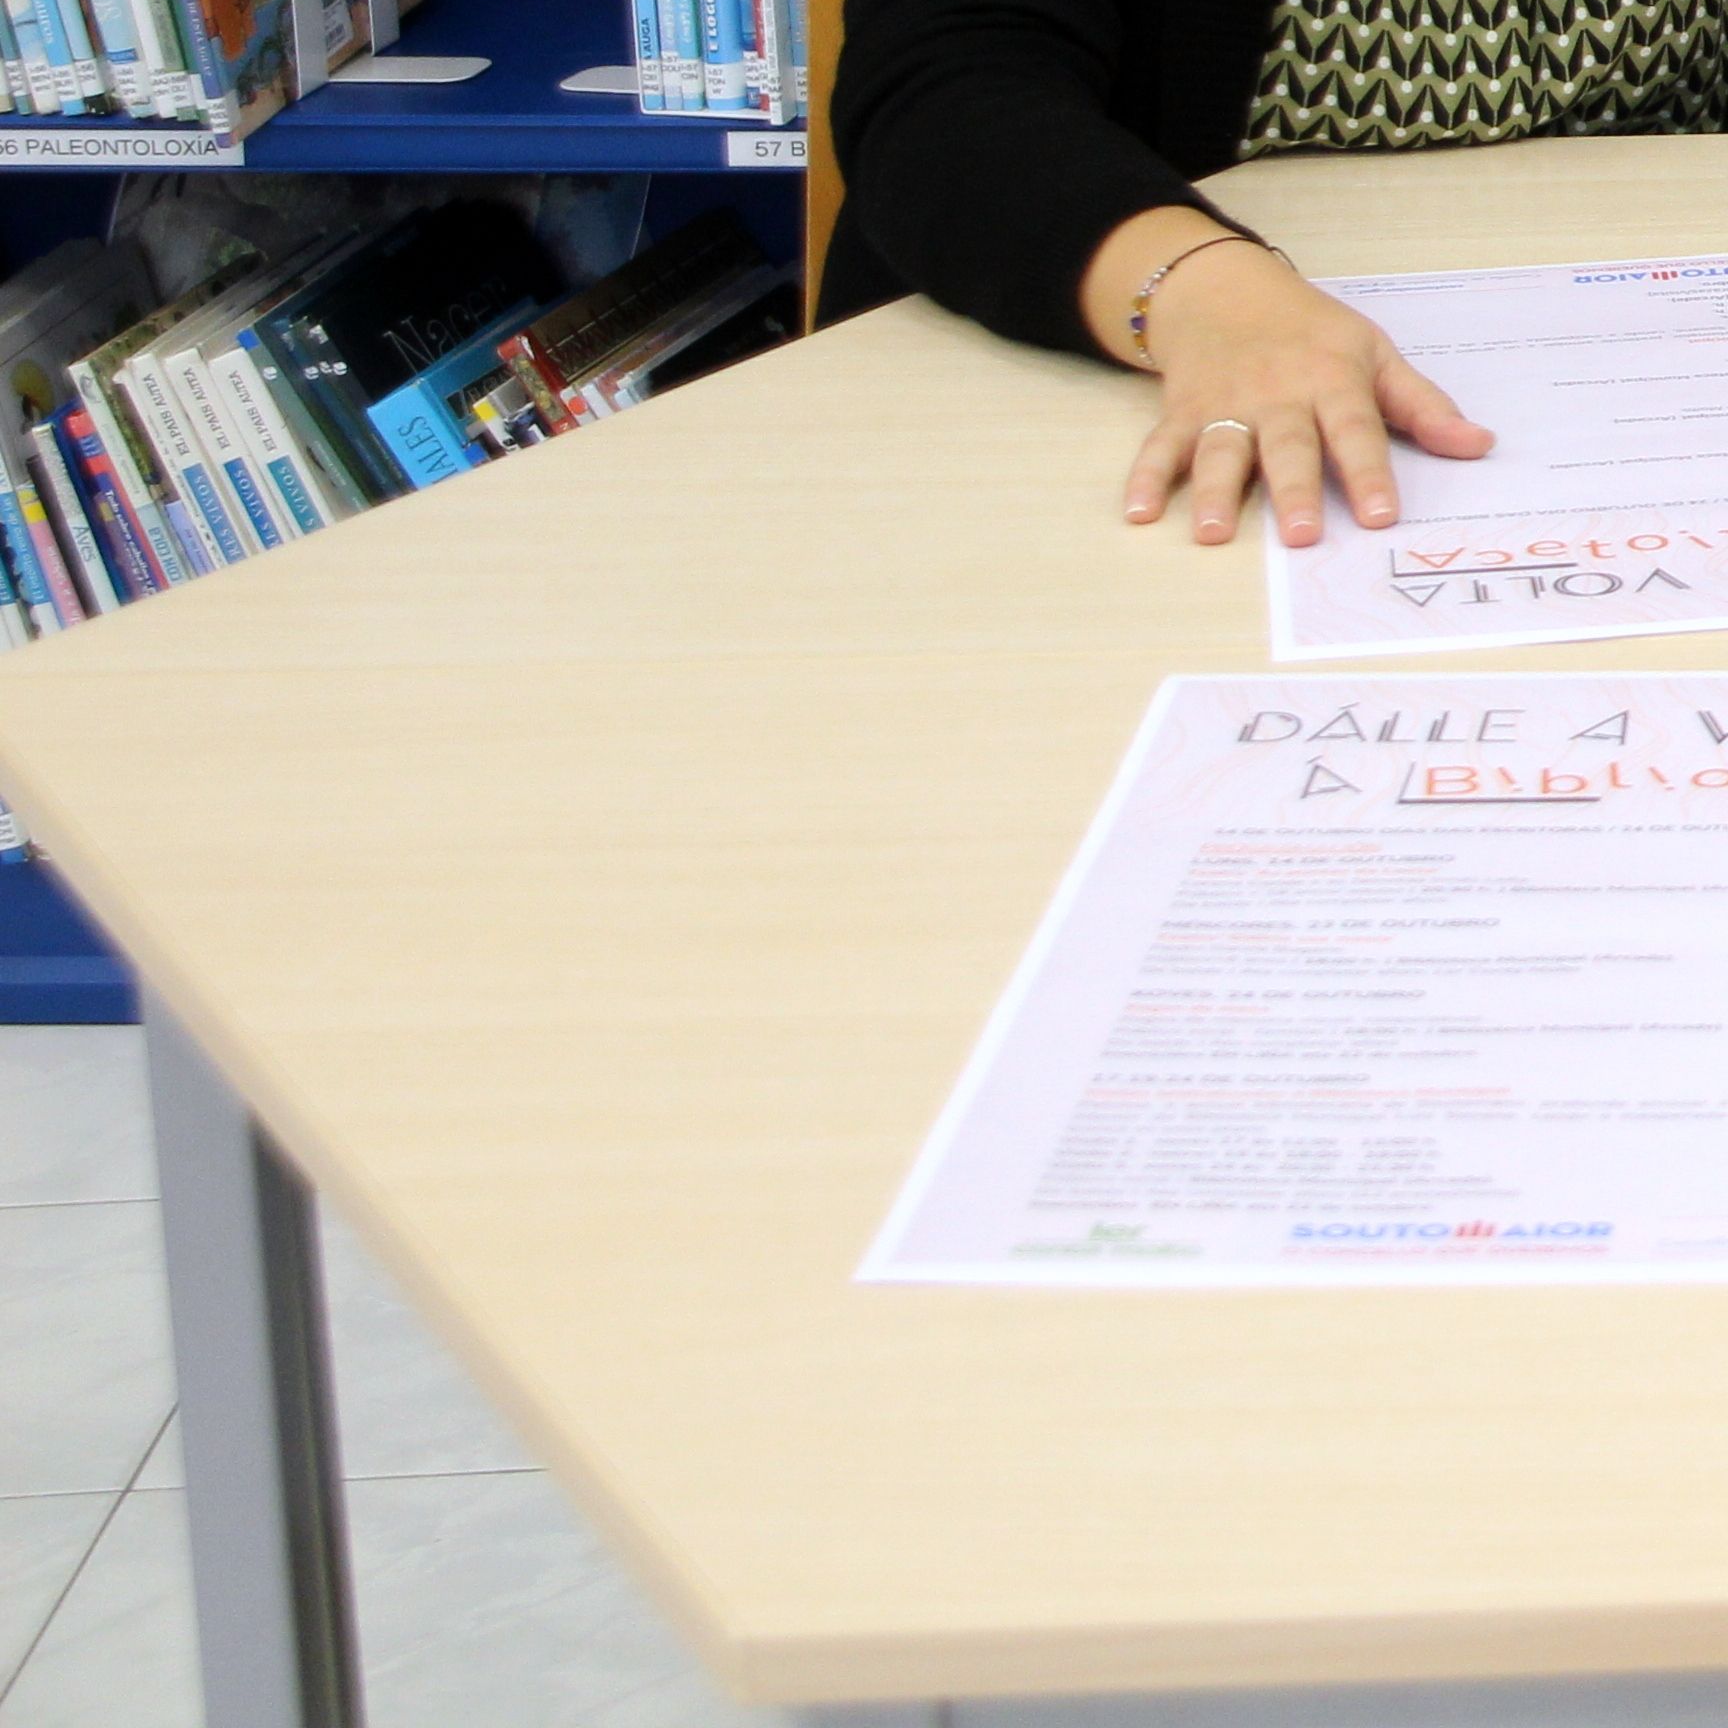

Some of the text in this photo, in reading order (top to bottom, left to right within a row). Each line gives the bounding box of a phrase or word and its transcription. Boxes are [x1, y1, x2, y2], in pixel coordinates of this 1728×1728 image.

[26, 135, 220, 156] PALEONTOLOXÍA
[755, 139, 784, 158] 57
[1387, 567, 1693, 608] VOLTA
[1236, 703, 1530, 747] DÁLLE
[1567, 709, 1633, 747] A
[1299, 755, 1363, 802] Á
